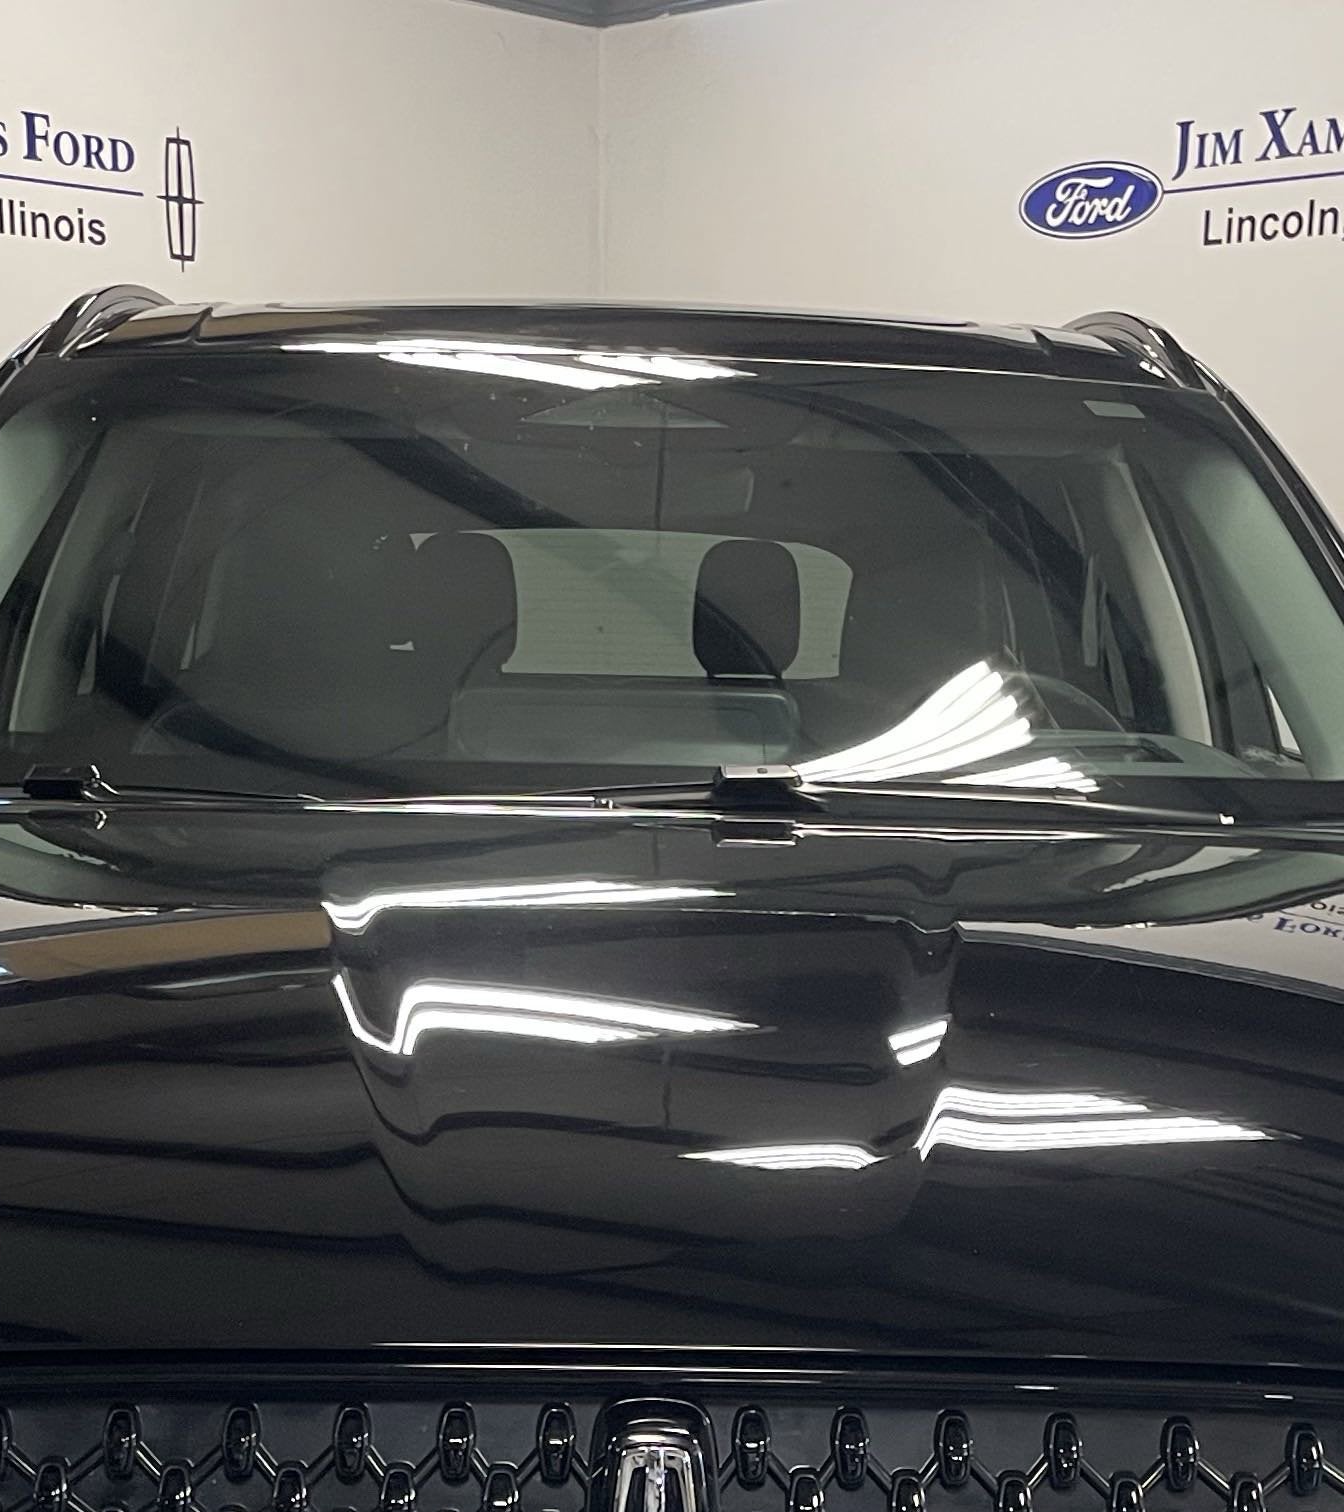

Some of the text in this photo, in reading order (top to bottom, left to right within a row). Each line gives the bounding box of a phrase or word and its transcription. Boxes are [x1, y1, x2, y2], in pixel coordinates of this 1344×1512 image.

[21, 111, 135, 172] FORD
[1172, 120, 1244, 180] JIM
[1045, 176, 1133, 226] Ford
